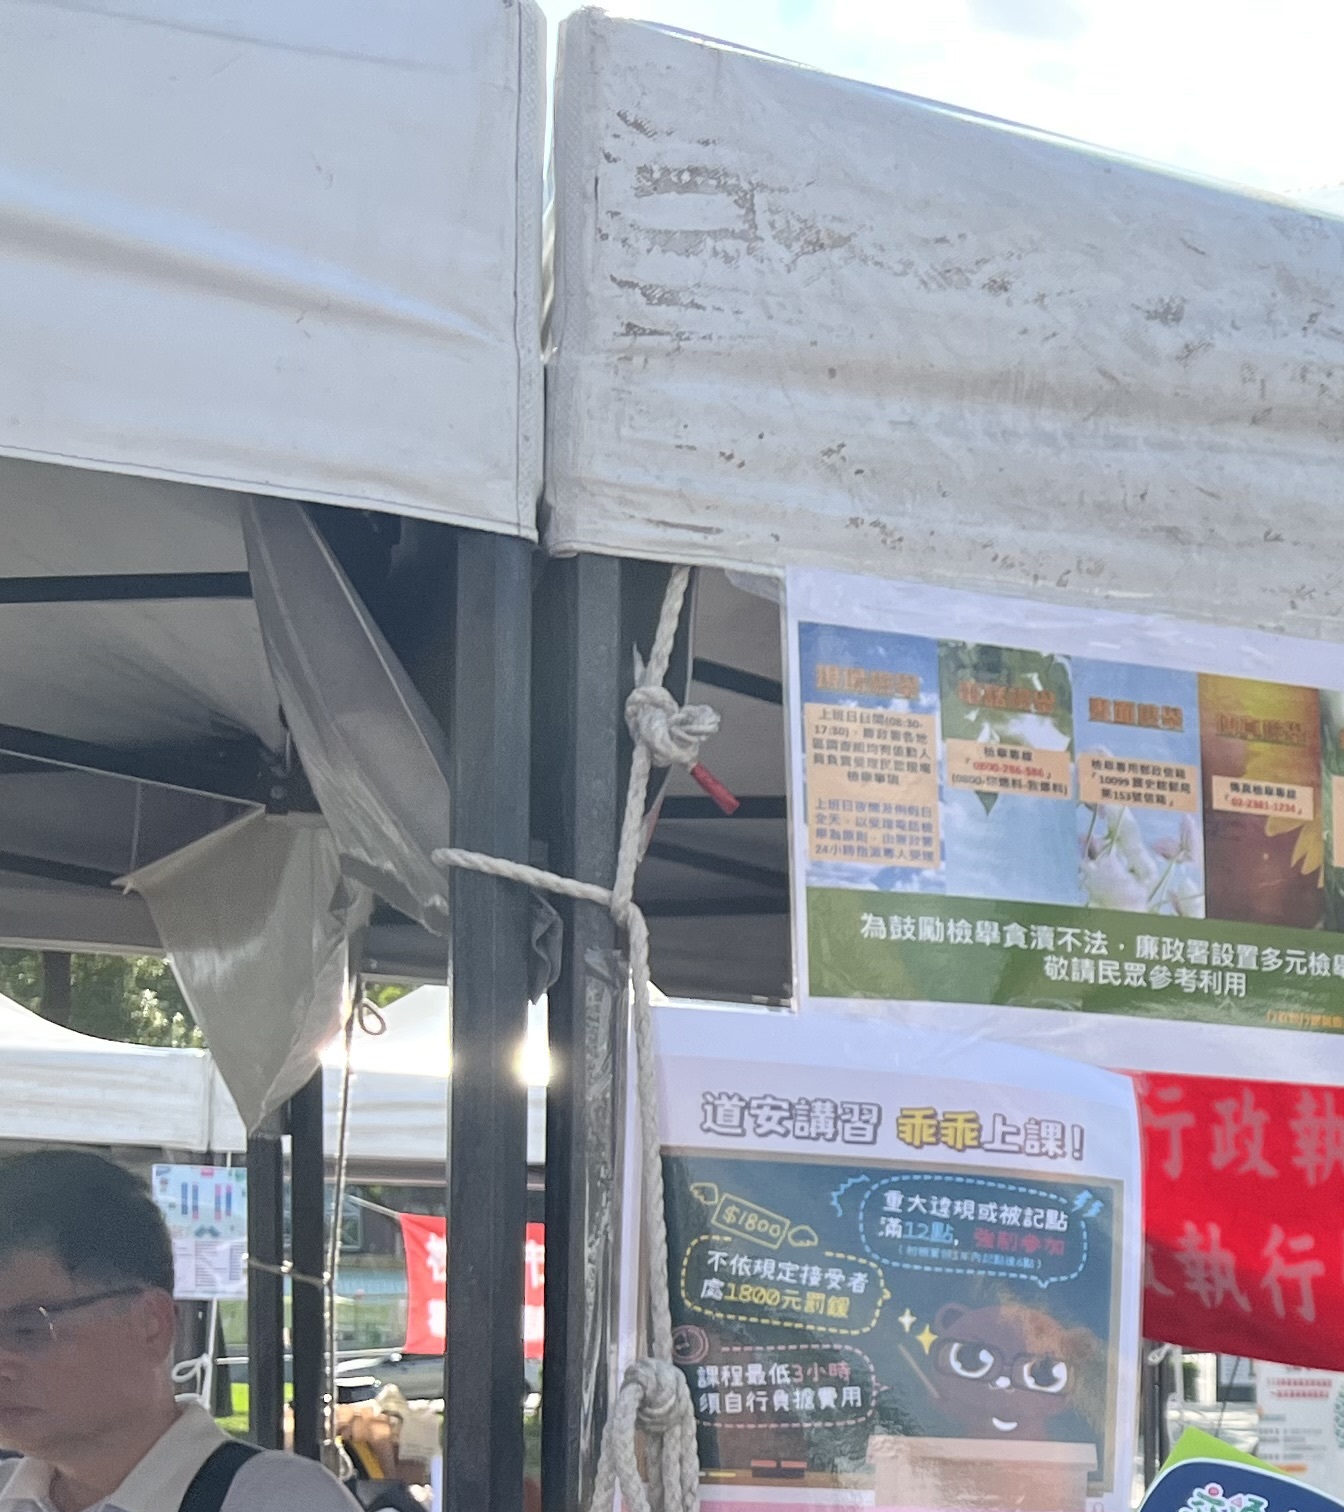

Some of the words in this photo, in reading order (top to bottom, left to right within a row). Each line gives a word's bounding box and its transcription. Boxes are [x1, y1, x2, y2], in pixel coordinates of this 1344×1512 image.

[1043, 956, 1248, 998] 敬請民眾參考利用
[700, 1090, 883, 1145] 道安講習
[721, 1203, 782, 1239] $1800
[882, 1188, 1069, 1232] 重大違規或被記點
[707, 1249, 869, 1294] 不依規定接受者
[700, 1277, 851, 1319] 處1800元罰鍰
[697, 1360, 852, 1389] 課程最低3小時
[699, 1385, 863, 1415] 須自行負擔費用
